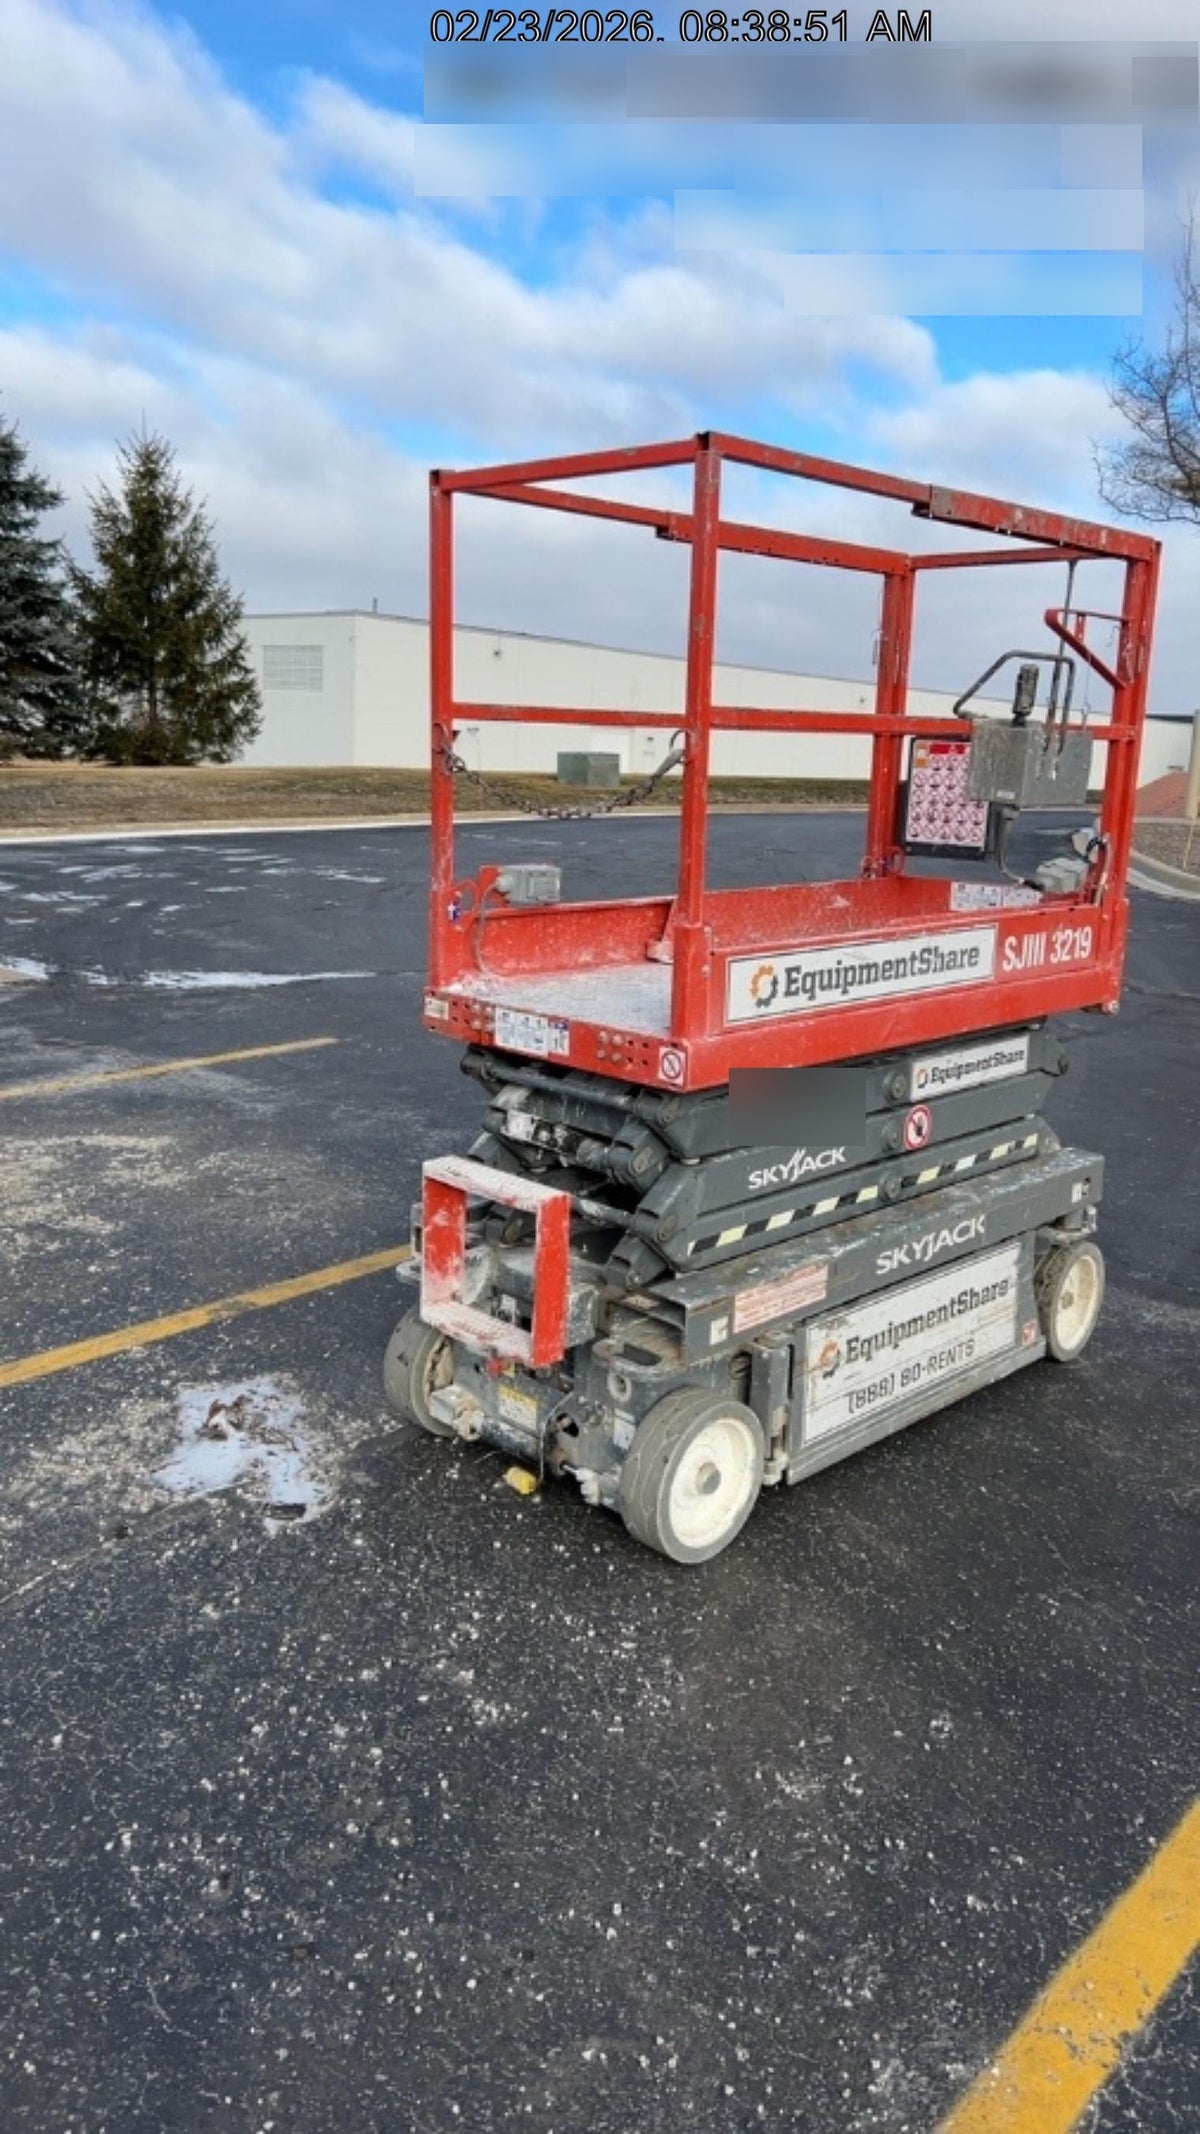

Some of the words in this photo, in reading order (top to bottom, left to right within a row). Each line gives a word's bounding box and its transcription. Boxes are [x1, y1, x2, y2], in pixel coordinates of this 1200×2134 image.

[1050, 926, 1092, 962] 3219
[783, 946, 980, 999] EquipmentShare
[930, 1049, 1025, 1085] EquipmentShare
[748, 1147, 847, 1190] SKYJACK
[876, 1214, 987, 1275] SKYJACK
[845, 1278, 1009, 1364] EquipmentShare
[848, 1374, 896, 1414] (888)
